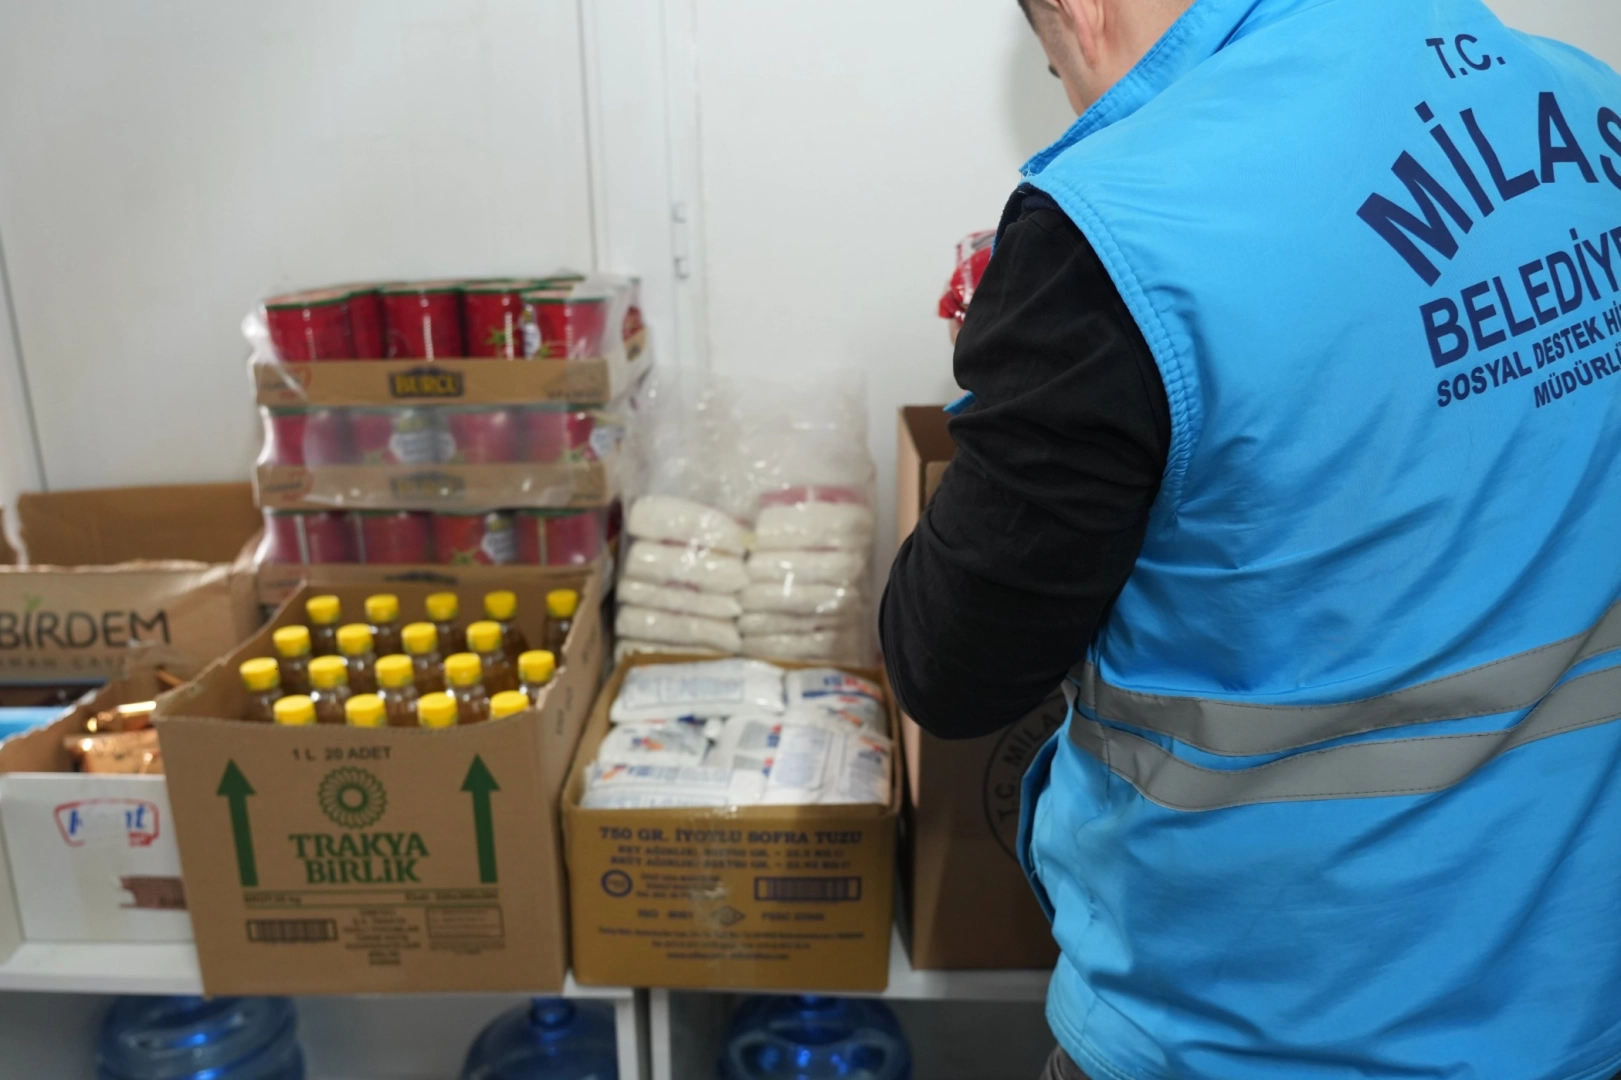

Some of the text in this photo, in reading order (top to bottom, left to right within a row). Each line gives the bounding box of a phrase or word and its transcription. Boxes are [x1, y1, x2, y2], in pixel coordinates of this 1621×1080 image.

[1425, 34, 1506, 79] T.C.
[1437, 351, 1533, 408] SOSYAL
[1532, 316, 1606, 369] DESTEK
[346, 745, 393, 761] ADET
[288, 832, 430, 859] TRAKYA
[747, 829, 808, 845] SOFRA
[815, 830, 863, 845] TUZU
